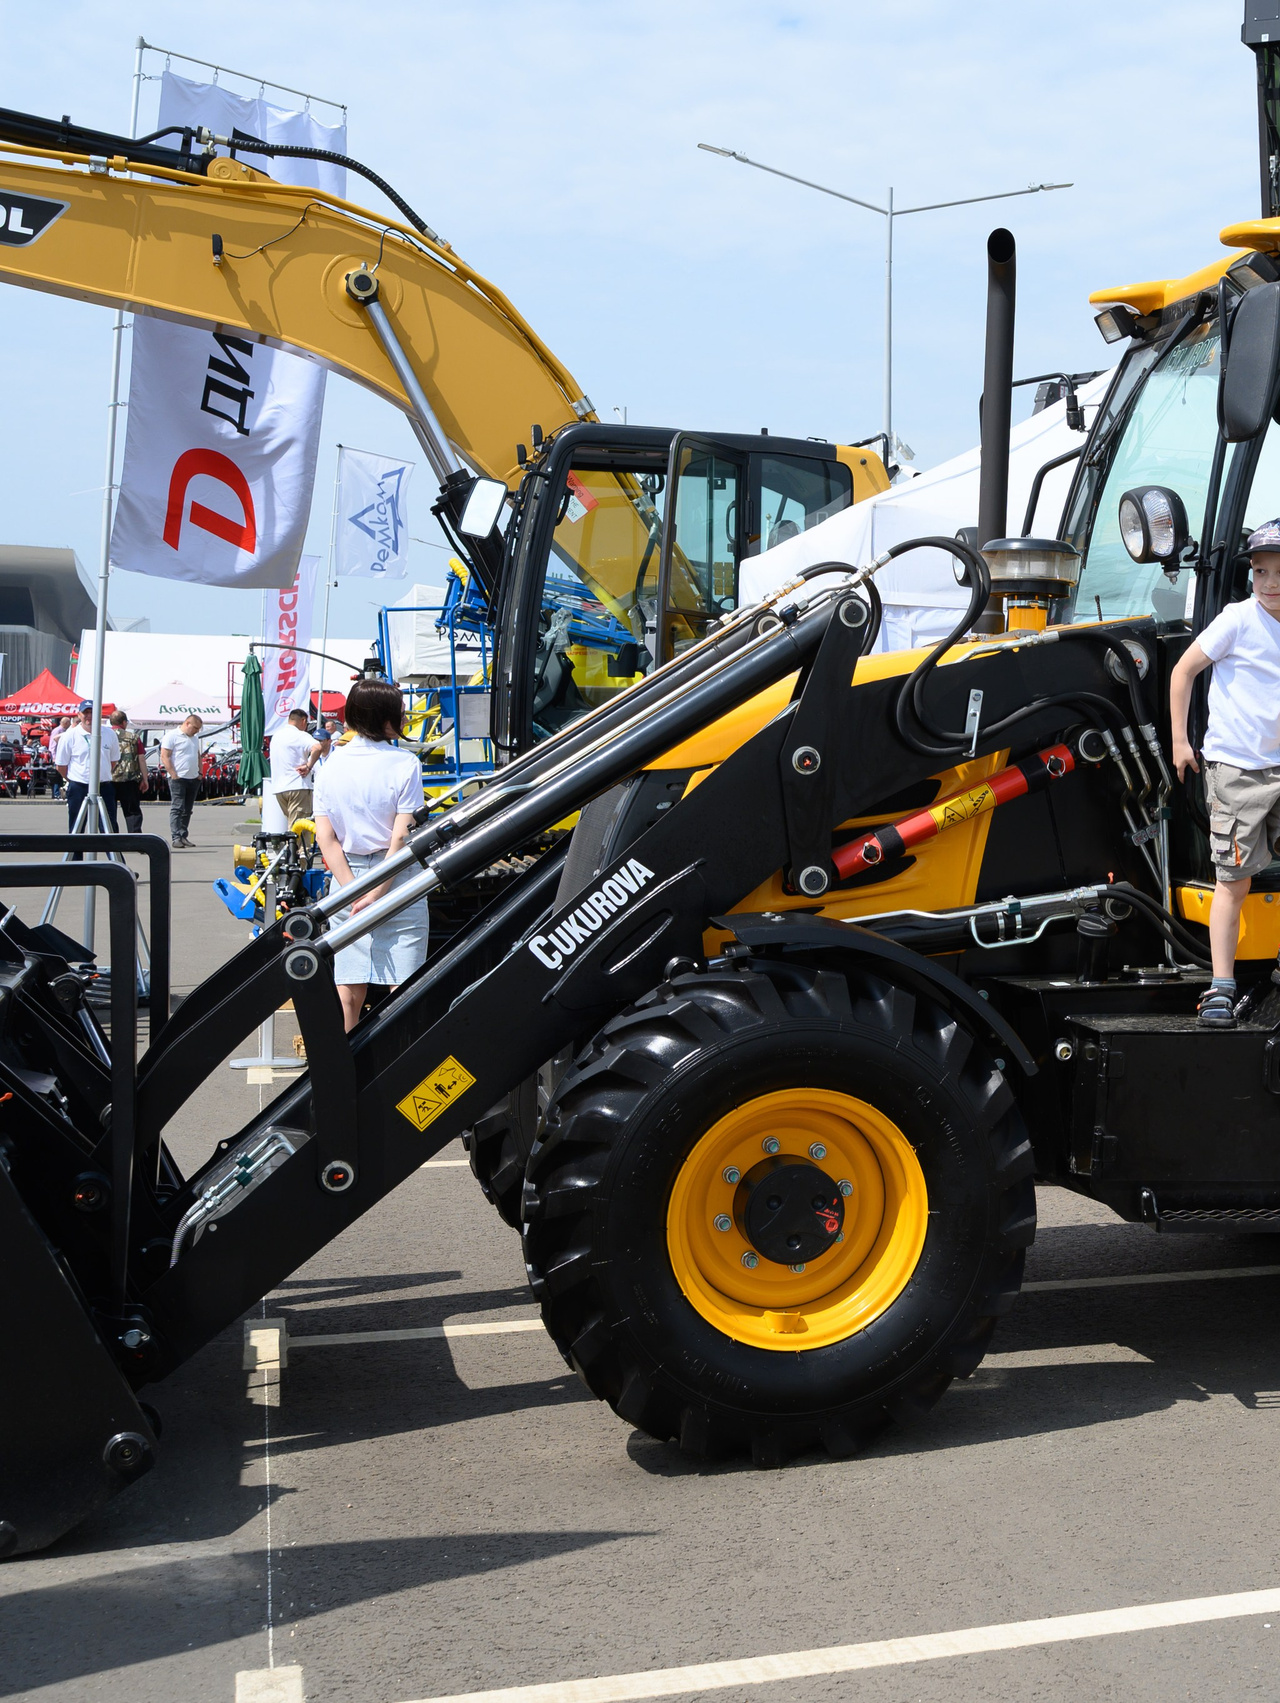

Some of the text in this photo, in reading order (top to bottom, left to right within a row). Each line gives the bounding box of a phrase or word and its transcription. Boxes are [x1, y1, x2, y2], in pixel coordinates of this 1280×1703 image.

[18, 702, 80, 714] HORSCH
[159, 704, 221, 715] Добрый
[528, 858, 656, 971] ÇUKUROVA
